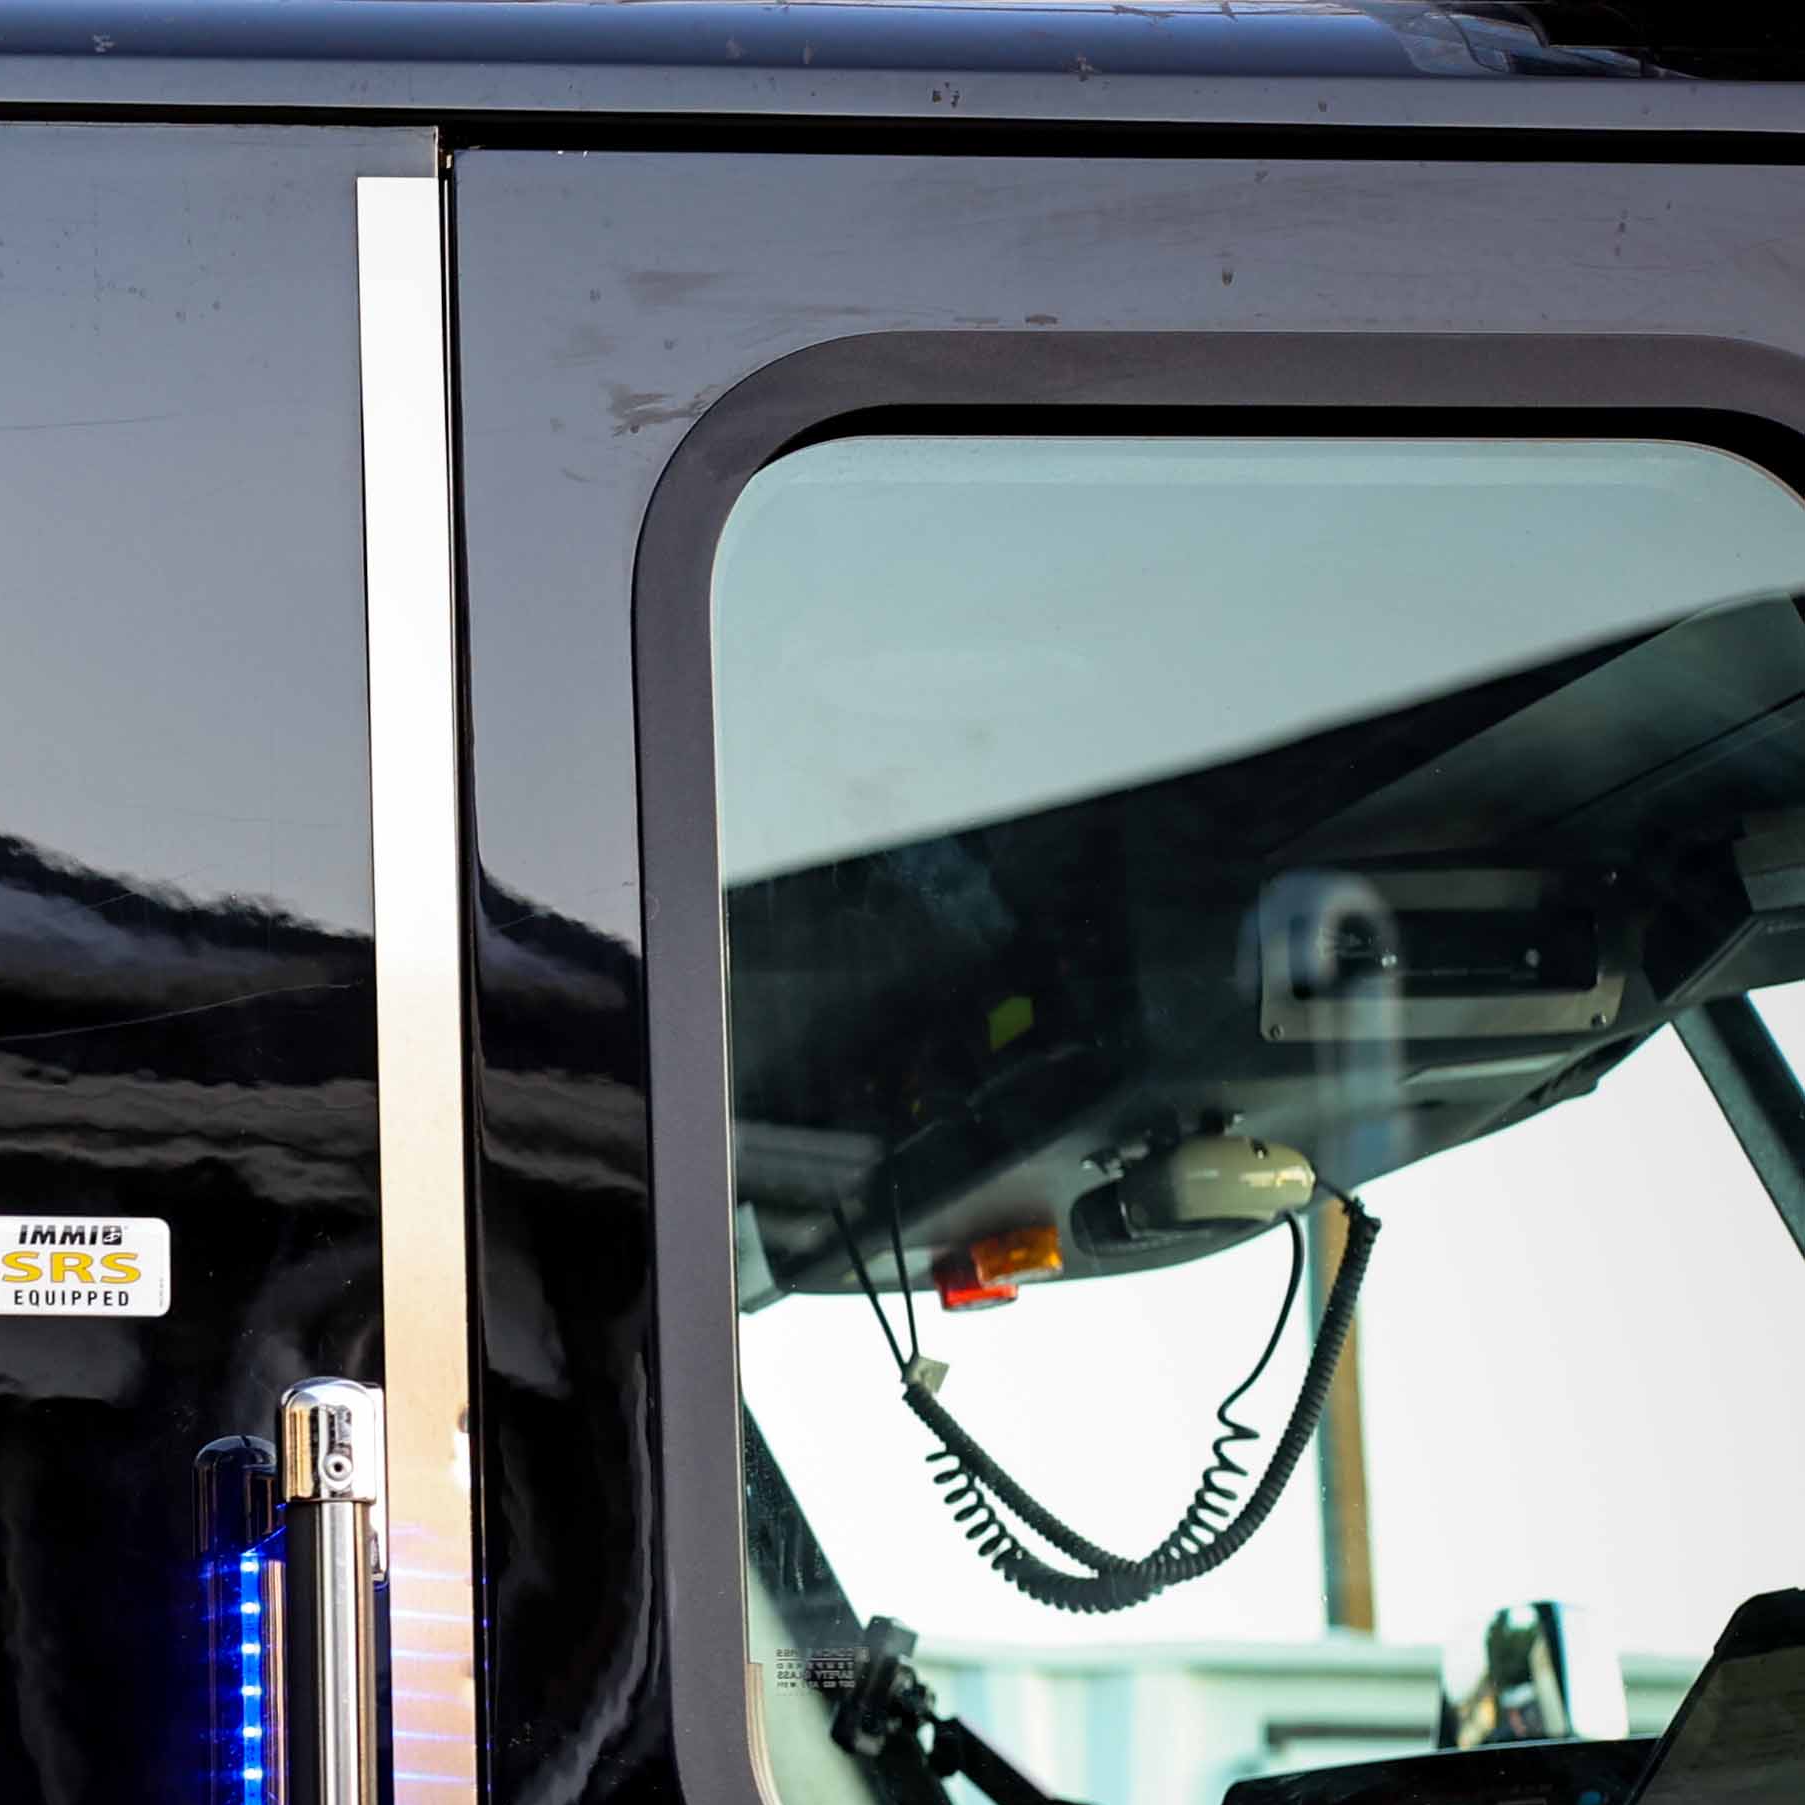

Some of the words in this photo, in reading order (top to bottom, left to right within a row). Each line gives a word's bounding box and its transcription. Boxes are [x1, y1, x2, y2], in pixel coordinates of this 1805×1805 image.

[18, 1225, 99, 1246] IMMI
[1, 1251, 142, 1284] SRS
[13, 1289, 130, 1307] EQUIPPED
